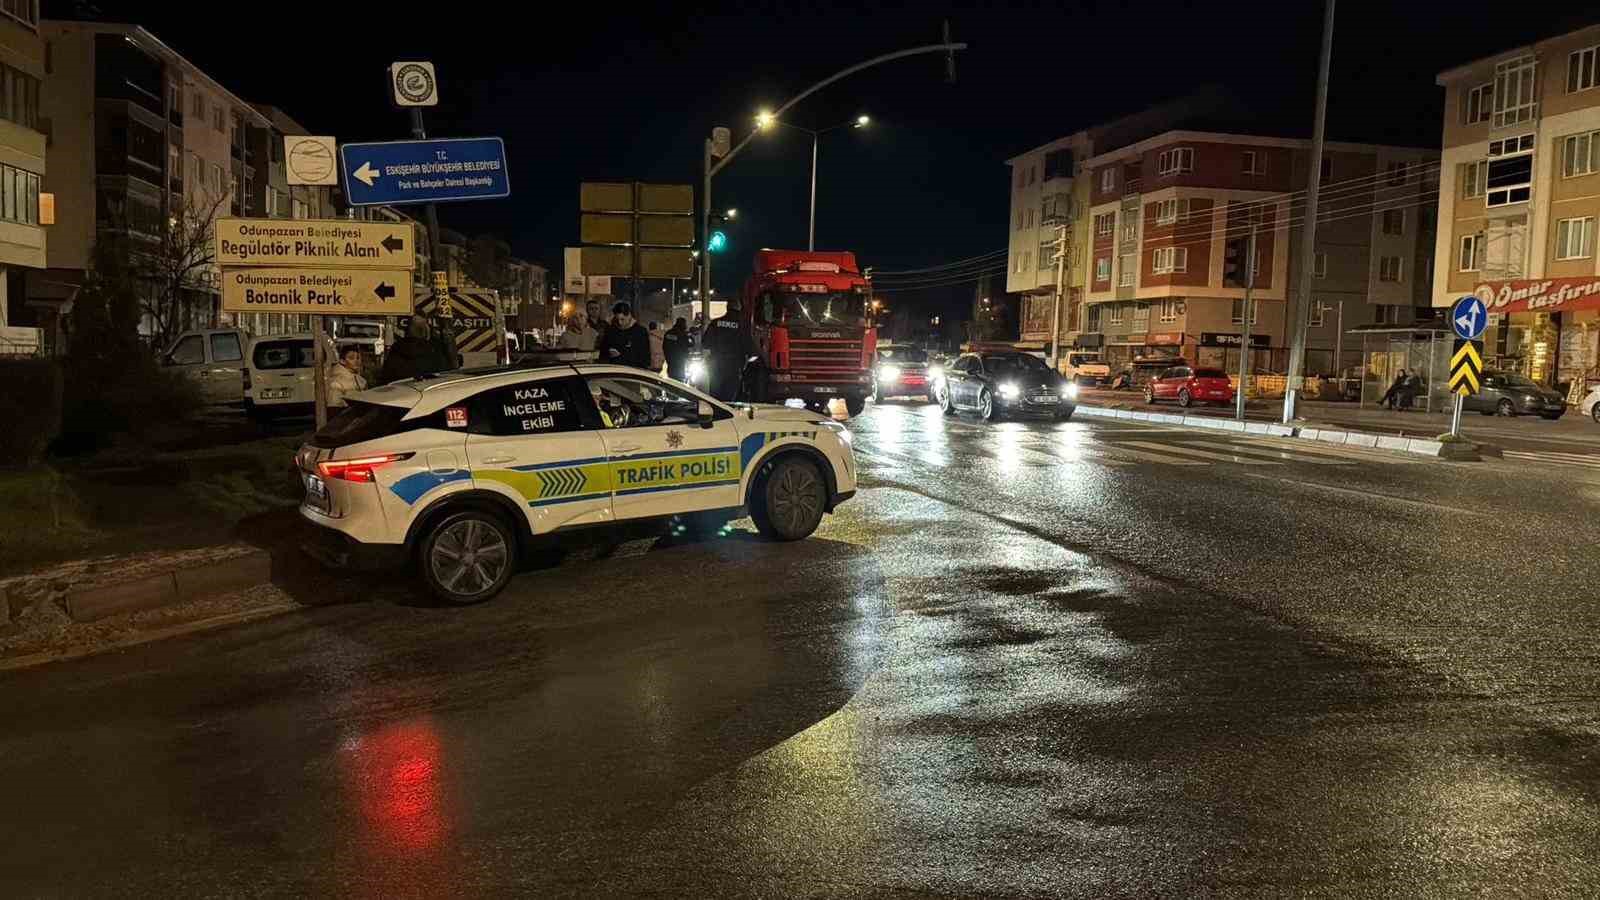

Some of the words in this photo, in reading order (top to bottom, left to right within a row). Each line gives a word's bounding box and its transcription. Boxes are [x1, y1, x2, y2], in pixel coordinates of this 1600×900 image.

[239, 225, 304, 238] Odunpazarı
[308, 227, 362, 239] Belediyesi
[221, 239, 290, 258] Regülatör
[295, 241, 340, 257] Piknik
[344, 242, 380, 257] Alanı
[236, 274, 297, 287] Odunpazarı
[299, 275, 352, 287] Belediyesi
[246, 289, 302, 304] Botanik
[308, 290, 343, 305] Park
[515, 388, 548, 400] KAZA
[448, 410, 465, 420] 112
[504, 400, 566, 417] İNCELEME
[522, 415, 555, 430] EKİBİ
[617, 461, 675, 484] TRAFİK
[681, 456, 730, 477] POLİSİ
